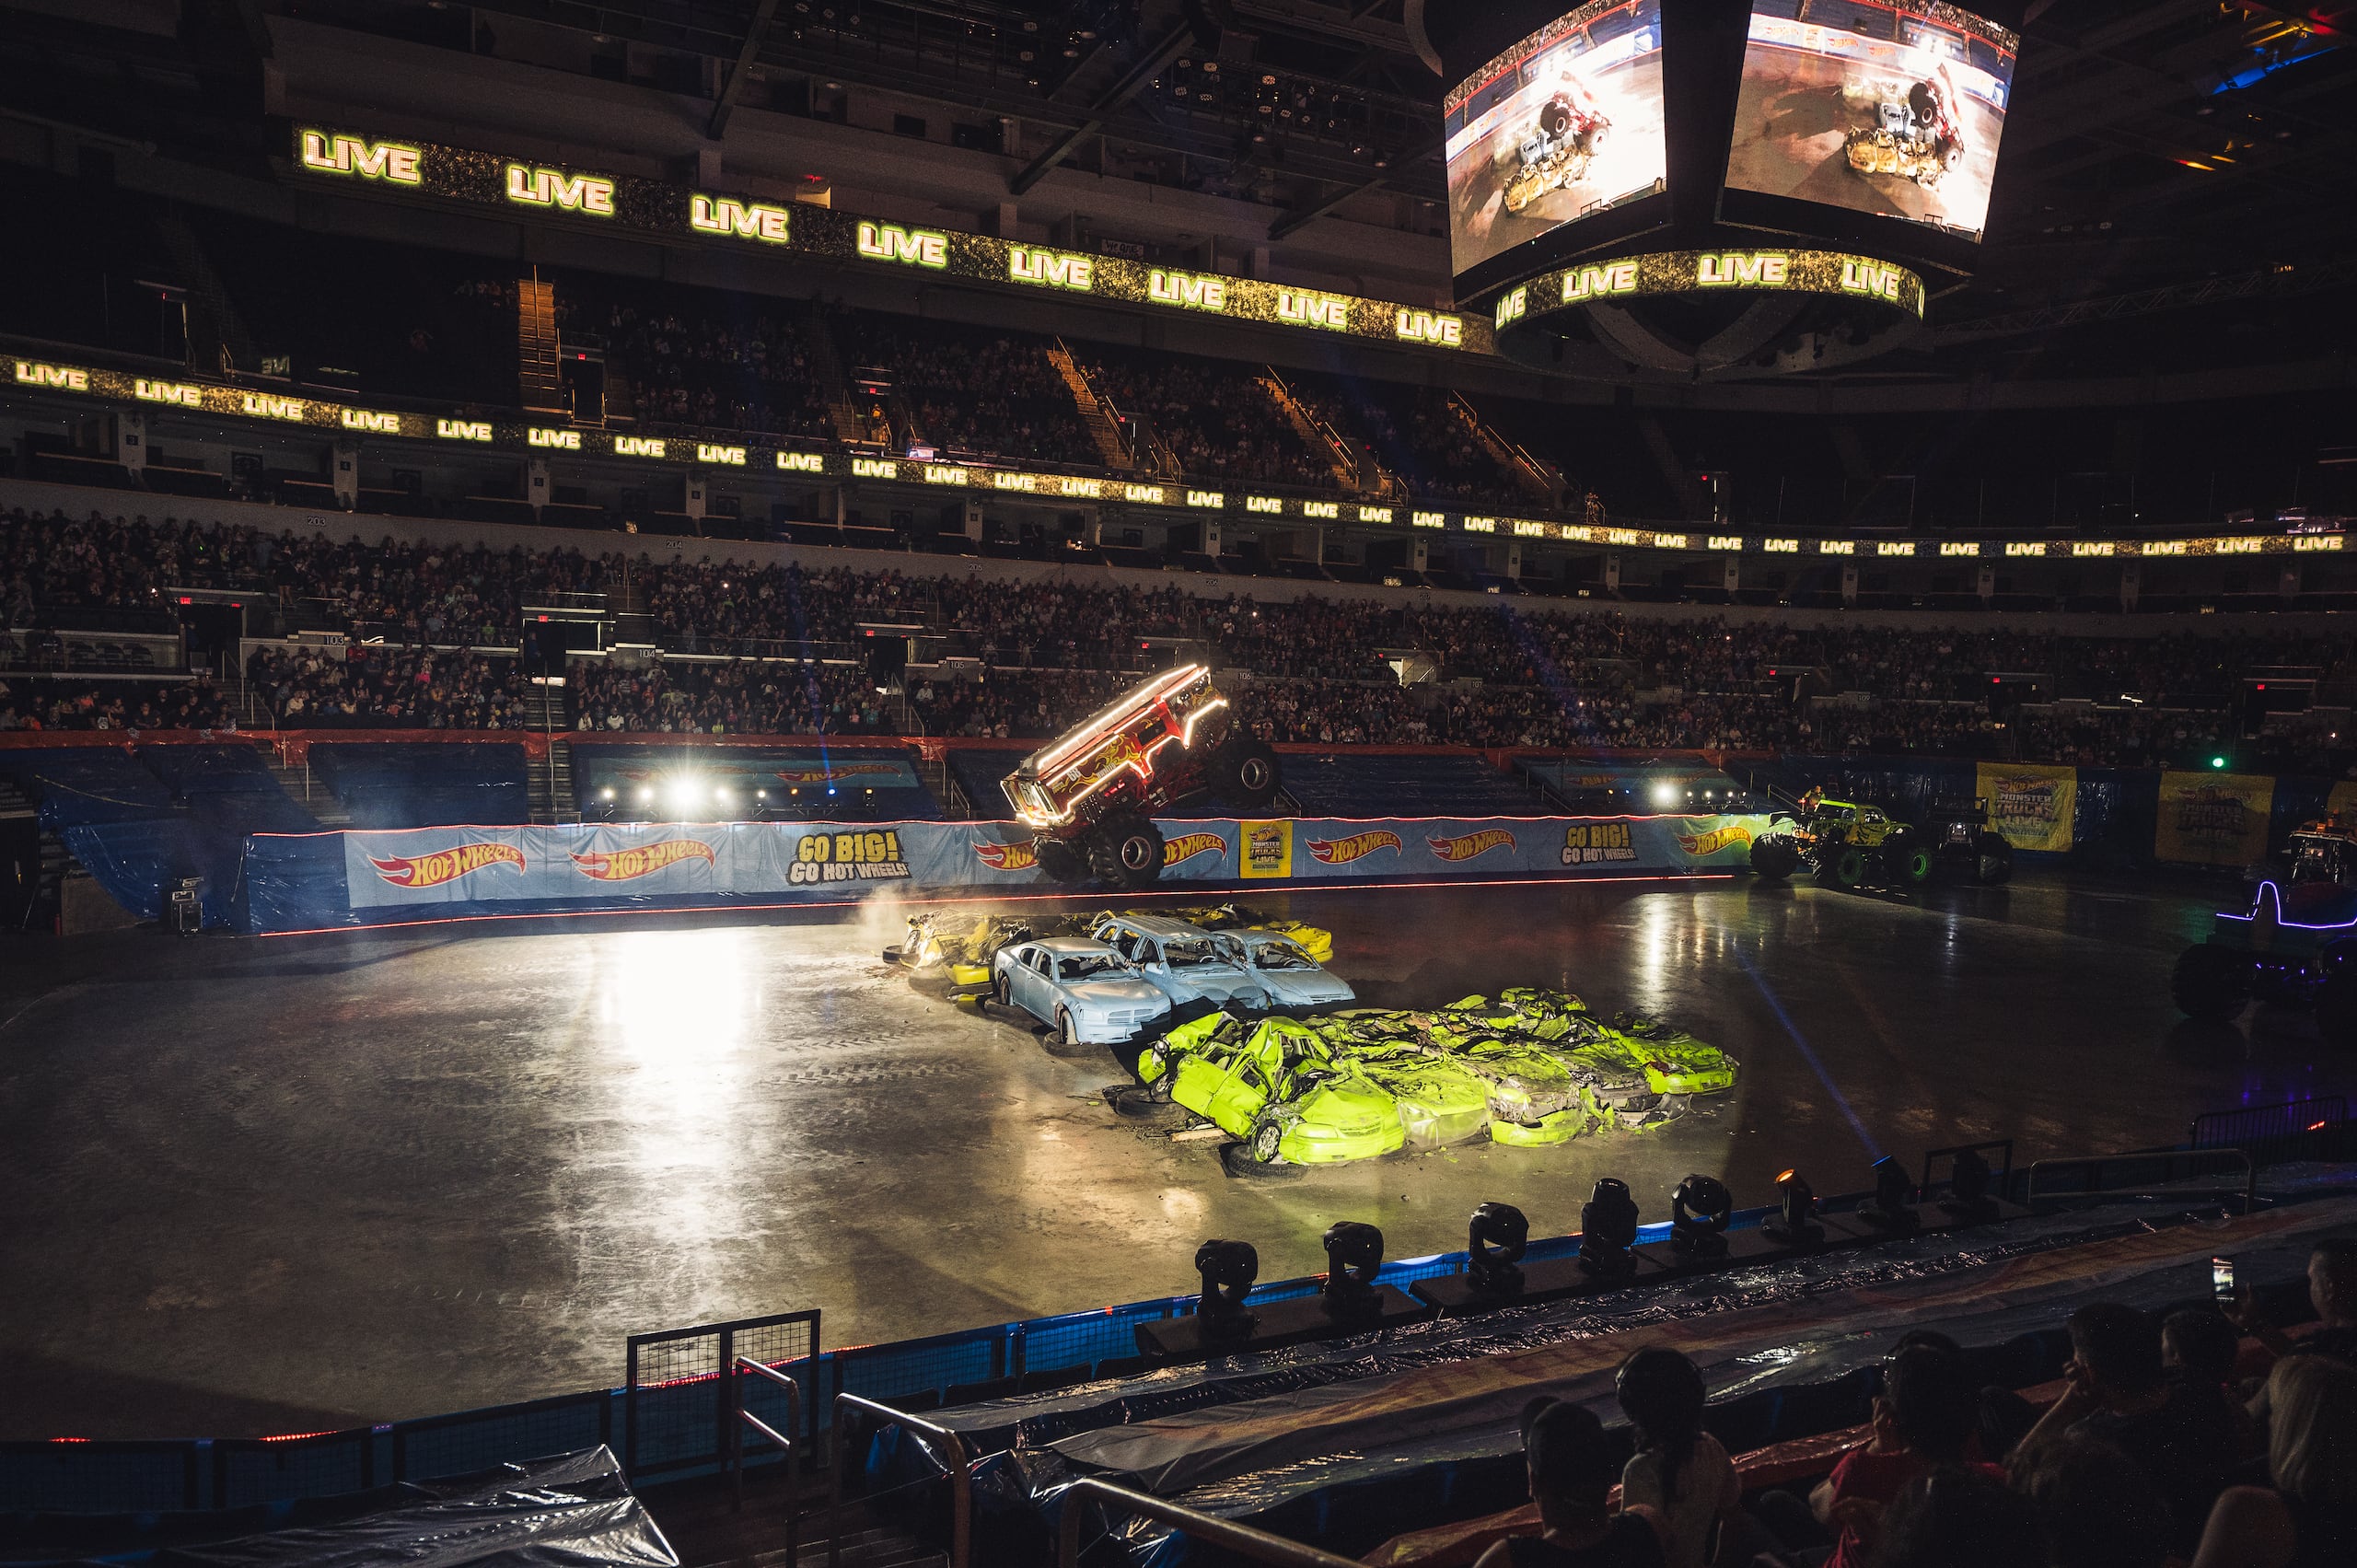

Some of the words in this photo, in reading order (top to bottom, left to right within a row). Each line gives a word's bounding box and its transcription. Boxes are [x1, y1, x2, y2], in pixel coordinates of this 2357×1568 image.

[304, 135, 419, 180] LIVE
[507, 167, 613, 214] LIVE
[691, 196, 788, 242] LIVE
[859, 224, 946, 266] LIVE
[1011, 248, 1091, 287] LIVE
[1150, 272, 1225, 308] LIVE
[1279, 293, 1348, 328] LIVE
[1397, 311, 1462, 345] LIVE
[1495, 288, 1526, 330] LIVE
[1564, 263, 1637, 299] LIVE
[1700, 254, 1787, 285] LIVE
[1842, 261, 1899, 298] LIVE
[17, 365, 87, 388] LIVE
[136, 382, 200, 406] LIVE
[244, 395, 303, 419] LIVE
[343, 410, 399, 432] LIVE
[438, 422, 491, 440] LIVE
[529, 430, 580, 448] LIVE
[616, 437, 664, 457] LIVE
[699, 445, 745, 463] LIVE
[778, 453, 822, 471] LIVE
[853, 459, 896, 478] LIVE
[925, 464, 969, 484] LIVE
[995, 473, 1036, 491] LIVE
[1059, 478, 1102, 496] LIVE
[1126, 485, 1163, 502] LIVE
[1188, 492, 1223, 507] LIVE
[1248, 497, 1282, 513] LIVE
[1305, 502, 1338, 517] LIVE
[1360, 507, 1391, 522] LIVE
[1413, 513, 1444, 527] LIVE
[1465, 517, 1494, 531] LIVE
[1515, 522, 1544, 536] LIVE
[1562, 526, 1591, 540] LIVE
[1608, 529, 1637, 544] LIVE
[1655, 534, 1686, 548] LIVE
[1709, 537, 1742, 550] LIVE
[1765, 539, 1798, 552] LIVE
[1820, 541, 1853, 553] LIVE
[1878, 543, 1914, 555] LIVE
[1941, 543, 1979, 555] LIVE
[2006, 544, 2046, 555] LIVE
[2073, 543, 2114, 555] LIVE
[2143, 542, 2186, 554] LIVE
[2216, 540, 2261, 552] LIVE
[2294, 537, 2342, 550] LIVE
[308, 516, 326, 527] 203
[665, 540, 683, 550] 204
[967, 563, 981, 572] 205
[325, 635, 344, 645] 103
[638, 648, 655, 658] 104
[950, 660, 964, 670] 105
[1238, 672, 1251, 680] 106
[1066, 766, 1083, 783] 68
[2001, 793, 2052, 803] MONSTER
[1996, 799, 2055, 818] TRUCKS
[1567, 826, 1587, 848] GO
[1590, 824, 1629, 848] BIG!
[799, 835, 830, 863] GO
[835, 831, 900, 863] BIG!
[1562, 847, 1581, 864] GO
[1583, 847, 1605, 863] HOT
[1605, 846, 1637, 862] WHEELS!
[790, 862, 819, 883] GO
[822, 862, 855, 881] HOT
[854, 862, 910, 879] WHEELS!
